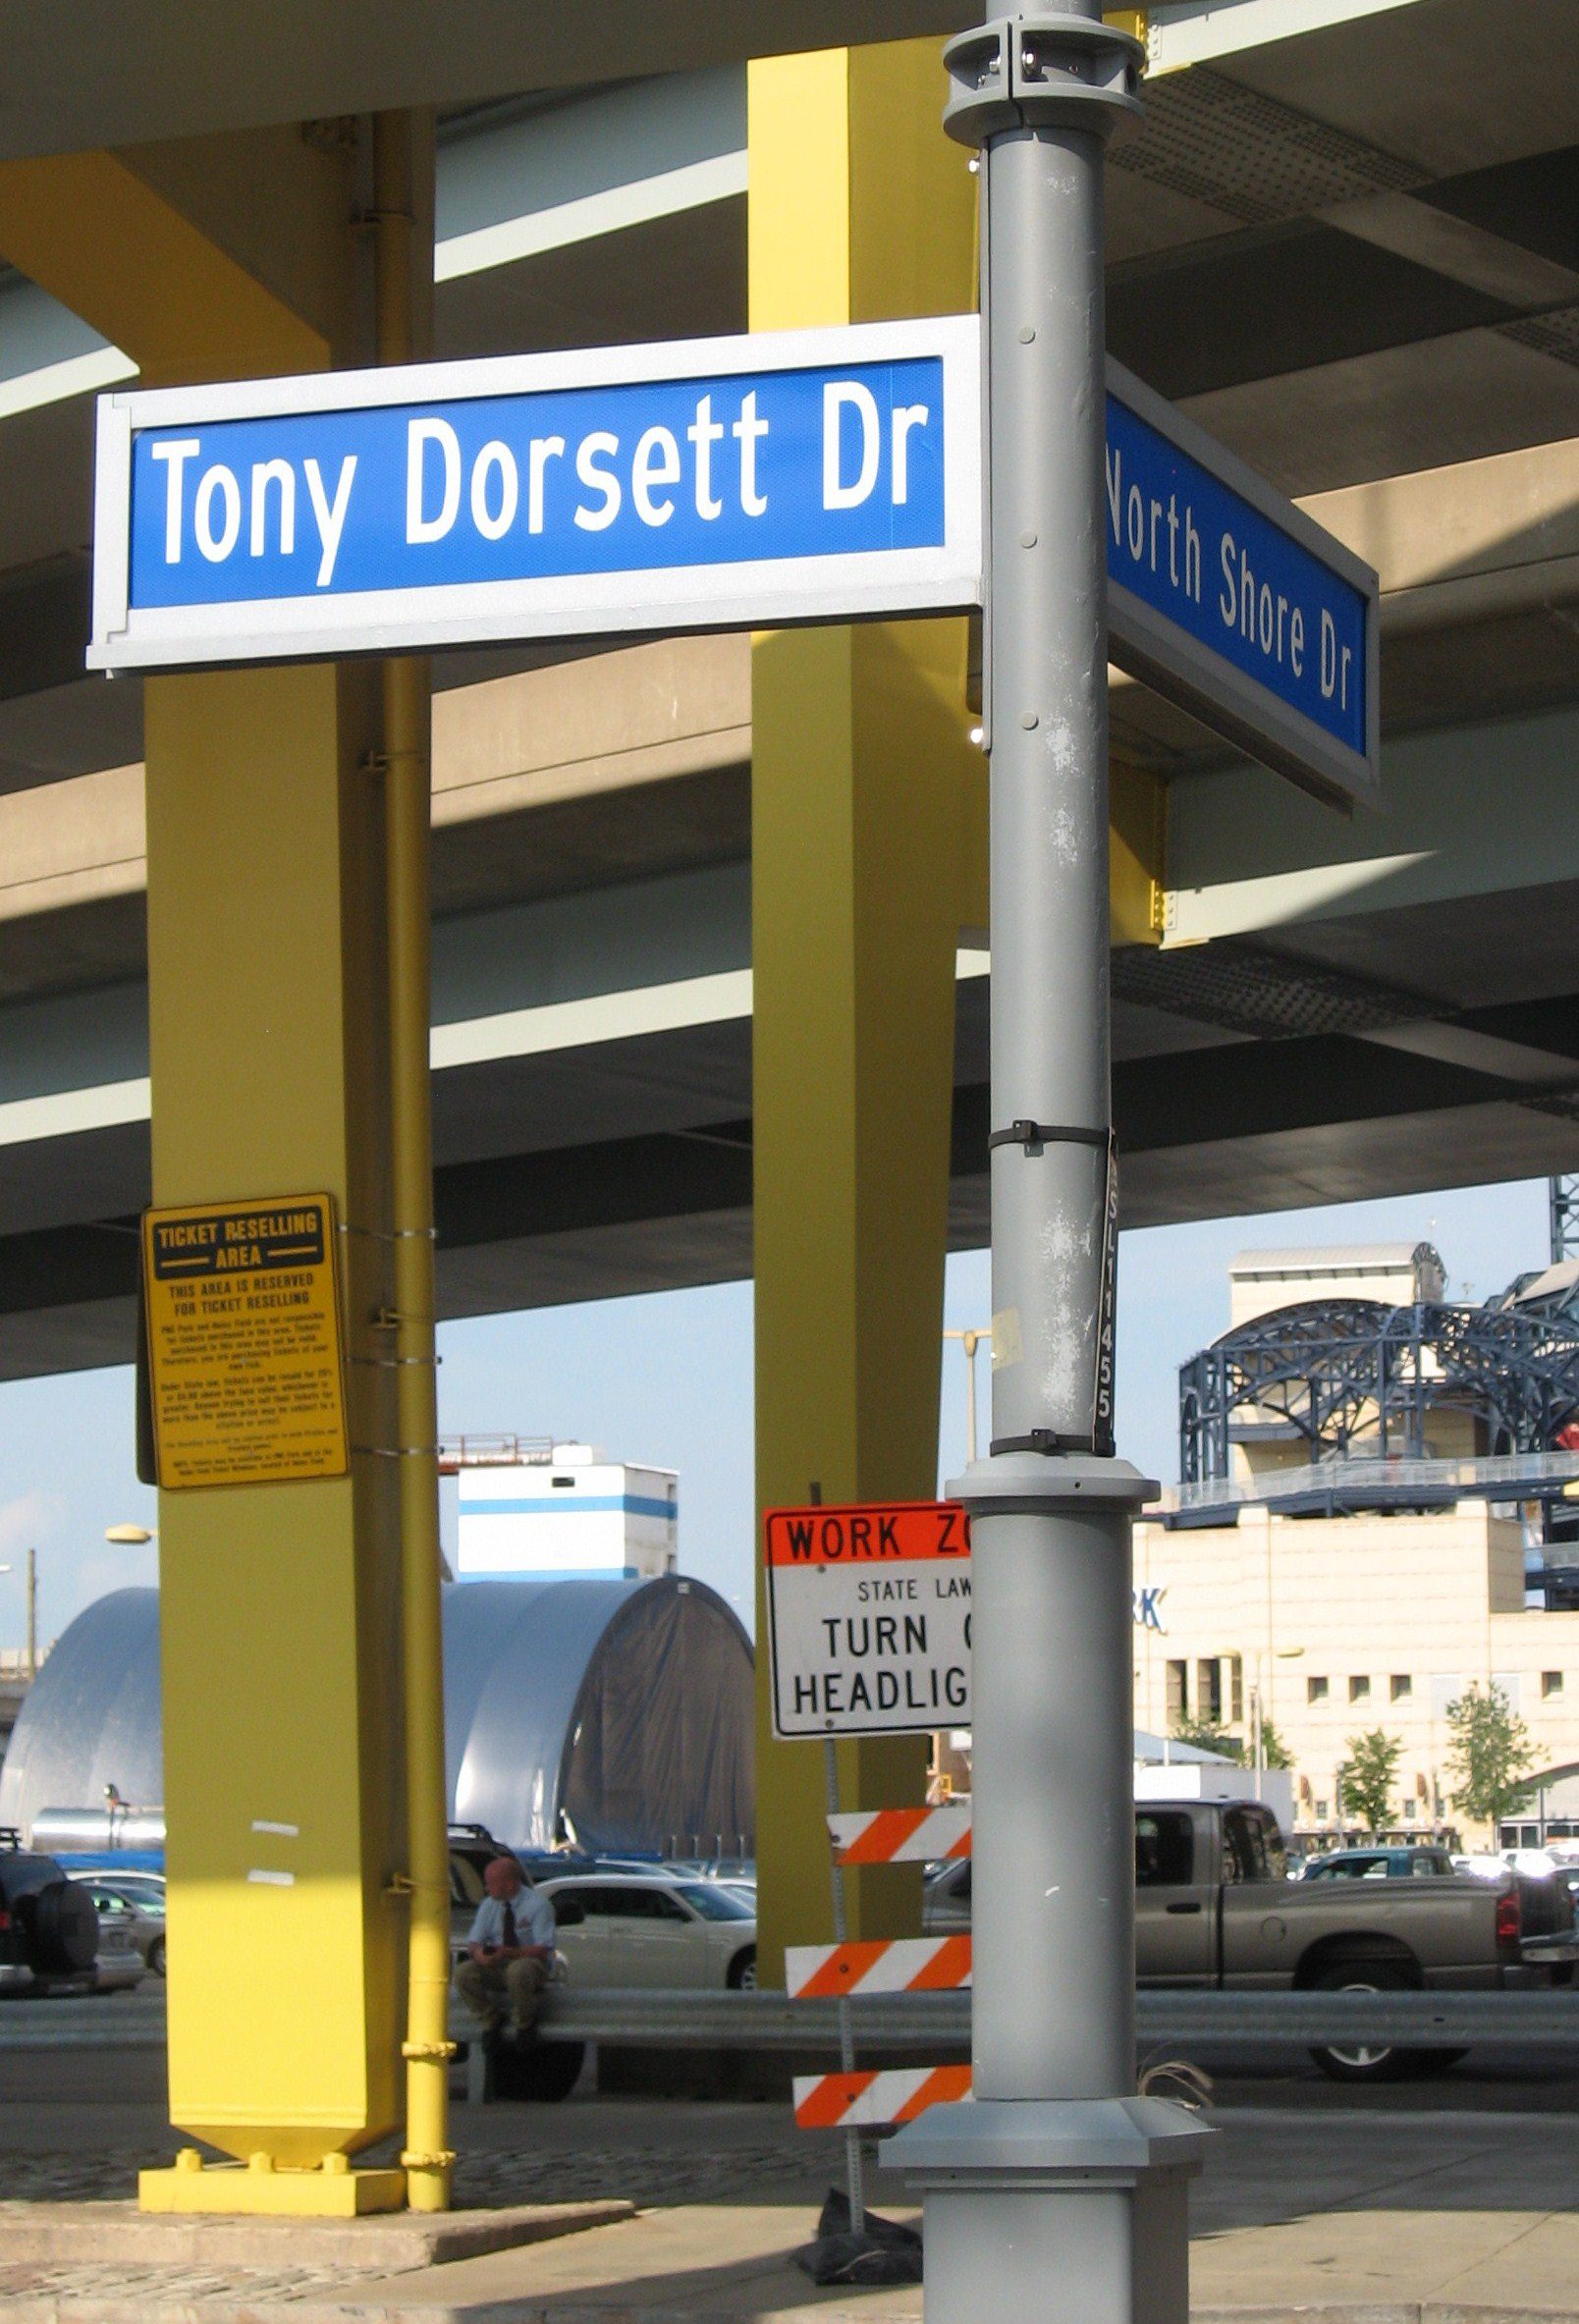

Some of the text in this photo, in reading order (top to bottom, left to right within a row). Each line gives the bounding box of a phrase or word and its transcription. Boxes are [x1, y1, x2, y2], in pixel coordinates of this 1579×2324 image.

[152, 380, 930, 587] Tony Dorsett Dr
[1106, 442, 1352, 712] North Shore Dr
[157, 1212, 318, 1249] TICKET RESELLING
[215, 1245, 262, 1269] AREA
[170, 1272, 314, 1299] THIS AREA IS RESERVED
[174, 1291, 309, 1317] FOR TICKET RESELLING
[787, 1513, 971, 1560] WORK Z
[857, 1578, 971, 1602] STATE LAW
[822, 1614, 927, 1658] TURN
[794, 1667, 967, 1714] HEADLIG
